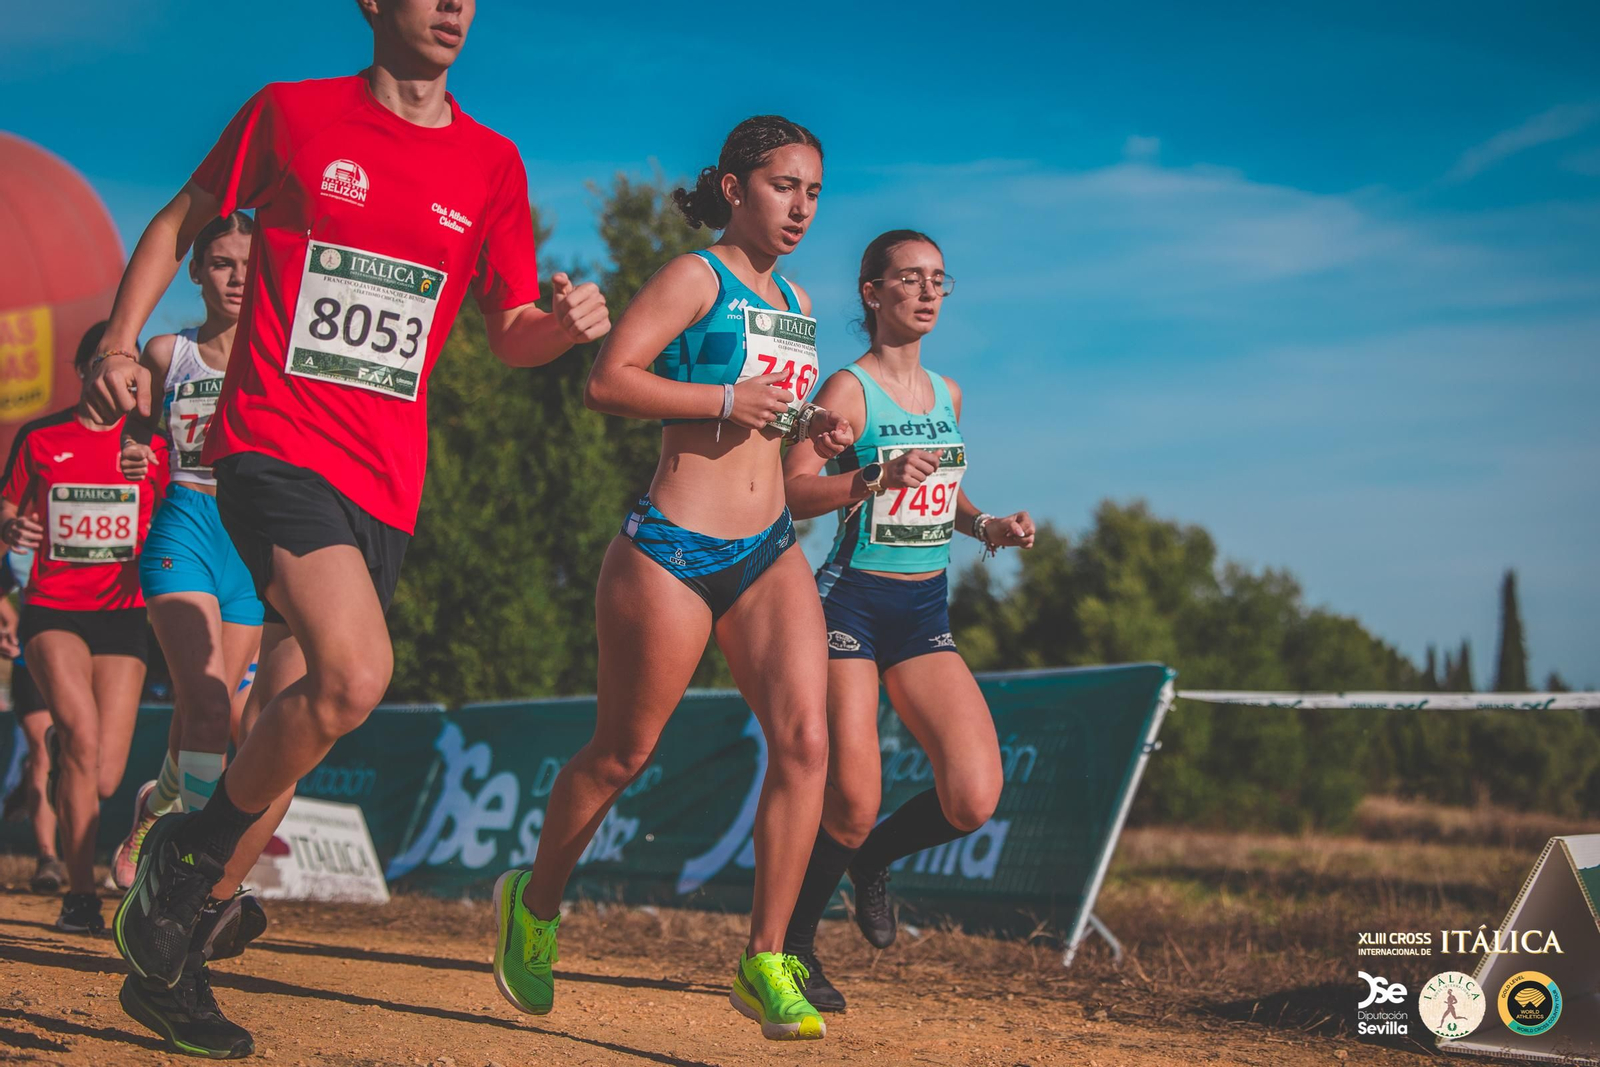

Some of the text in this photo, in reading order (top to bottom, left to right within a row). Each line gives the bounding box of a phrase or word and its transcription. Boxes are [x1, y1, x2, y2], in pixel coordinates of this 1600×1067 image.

[350, 256, 415, 285] ITÁLICA
[309, 297, 423, 359] 8053
[879, 418, 952, 440] nerja
[58, 514, 131, 540] 5488
